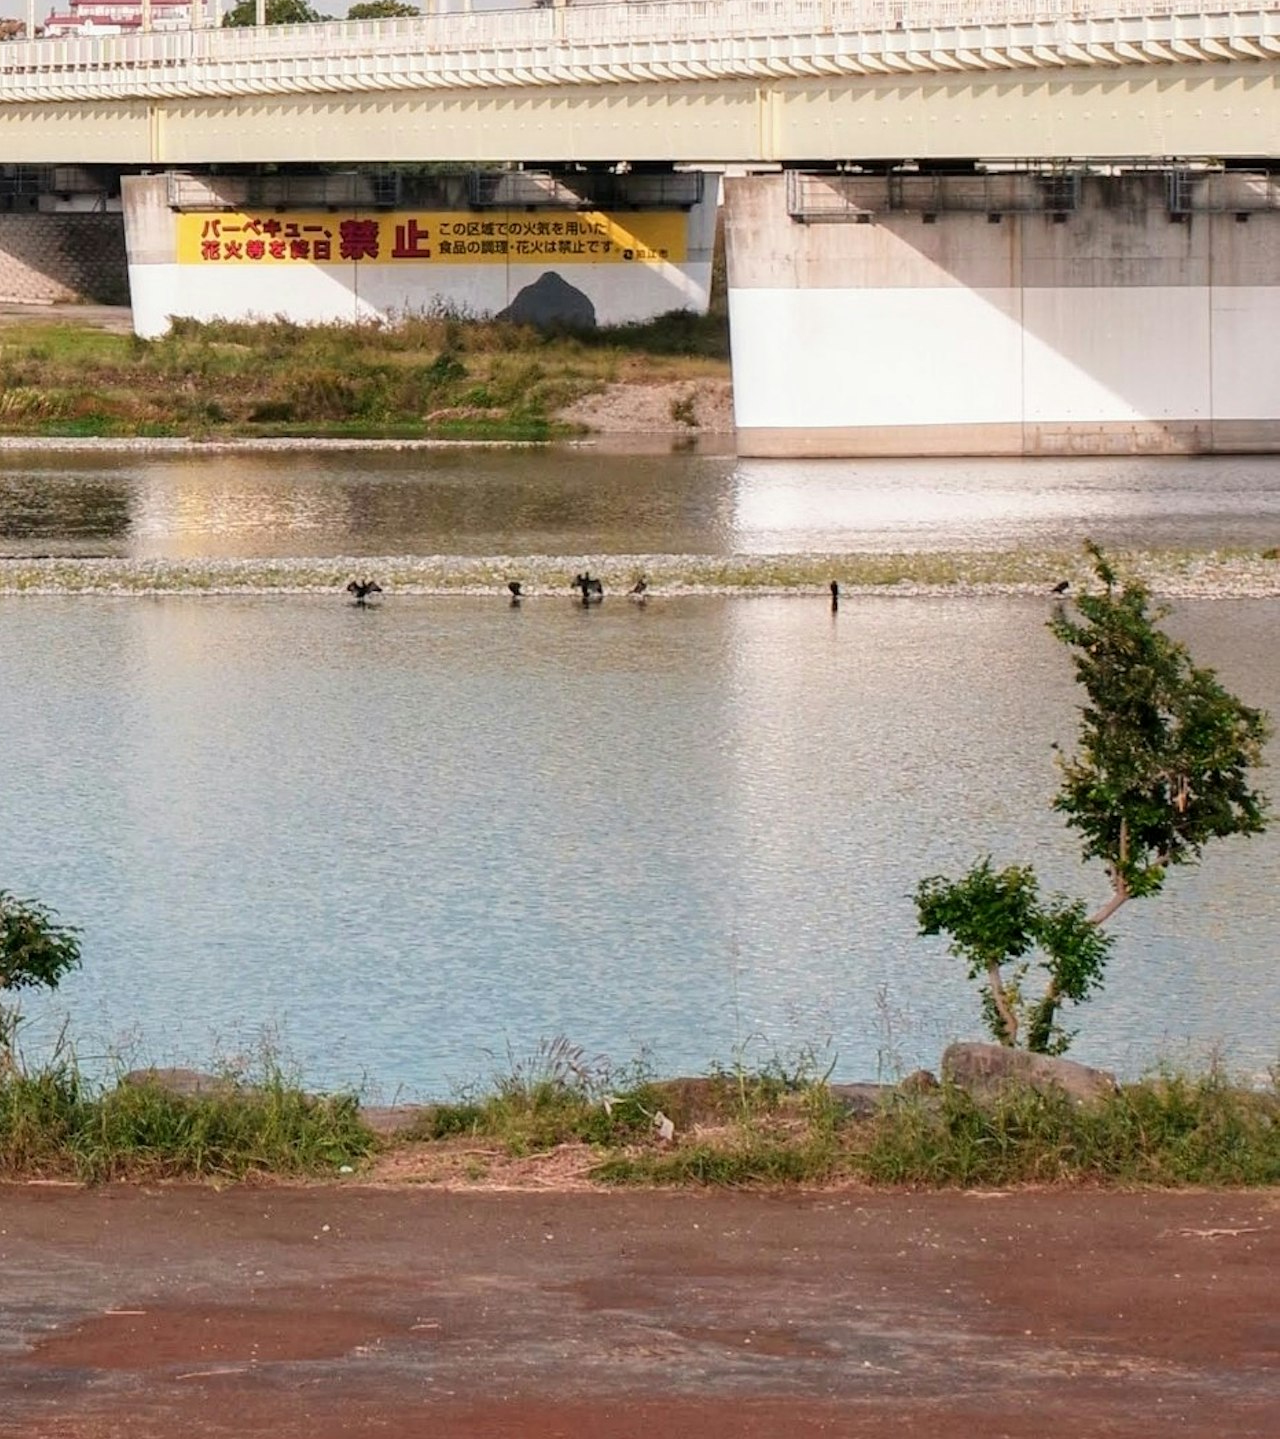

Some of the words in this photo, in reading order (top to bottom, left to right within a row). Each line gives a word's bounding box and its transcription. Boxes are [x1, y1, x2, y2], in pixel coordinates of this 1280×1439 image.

[438, 221, 608, 236] この区域での火気を用いた
[339, 219, 430, 260] 禁止
[201, 240, 331, 260] 花火等を終日
